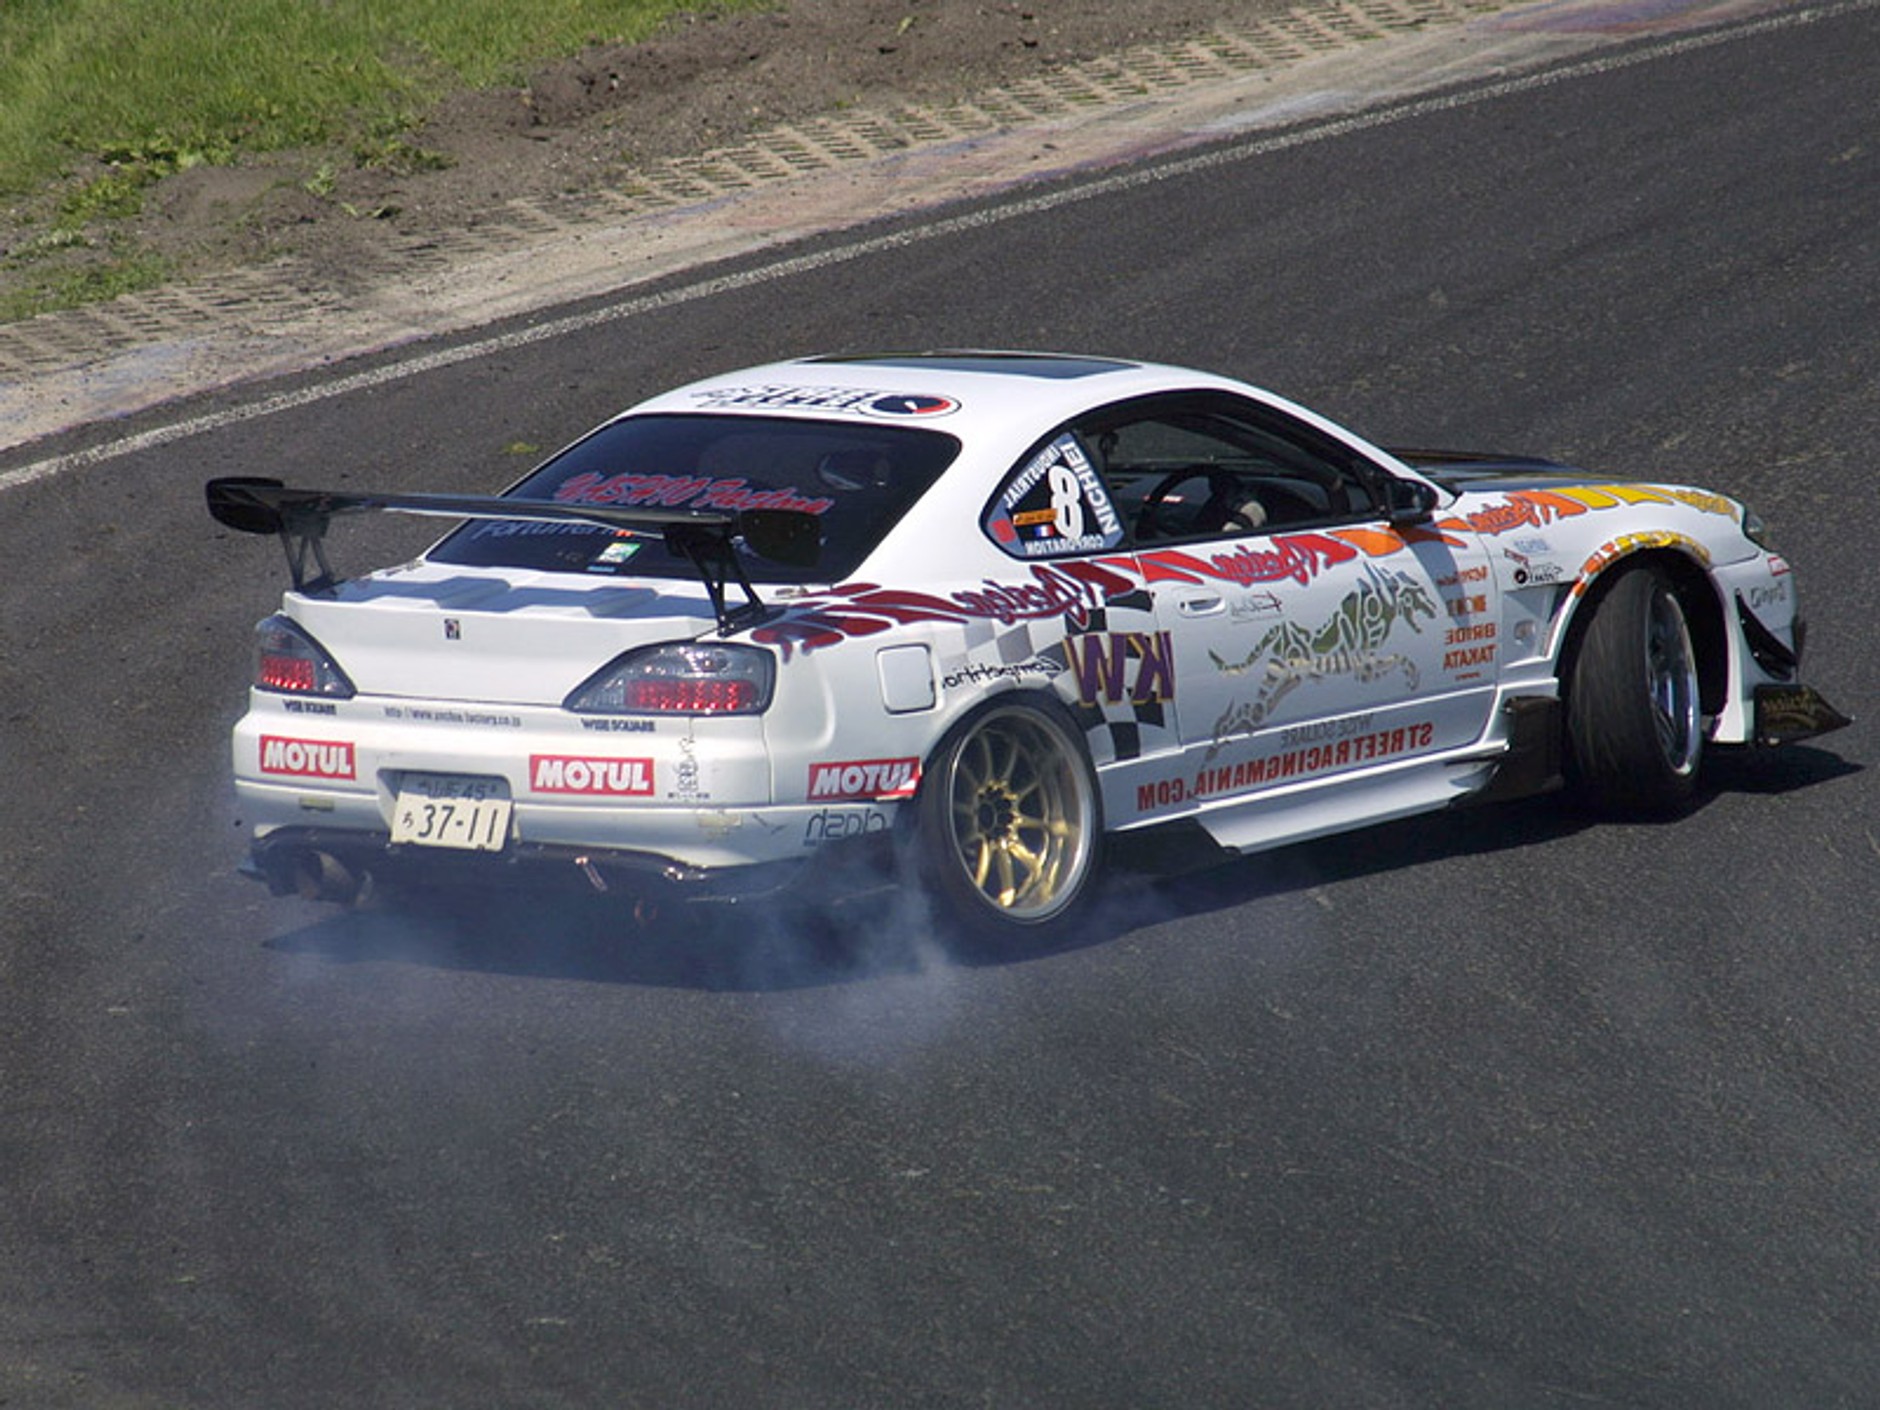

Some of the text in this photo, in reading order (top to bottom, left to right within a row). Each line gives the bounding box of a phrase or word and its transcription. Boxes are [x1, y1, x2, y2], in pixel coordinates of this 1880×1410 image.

[263, 740, 352, 776] MOTUL
[535, 759, 650, 791] MOTUL
[812, 762, 917, 795] MOTUL
[417, 803, 499, 844] 37-11
